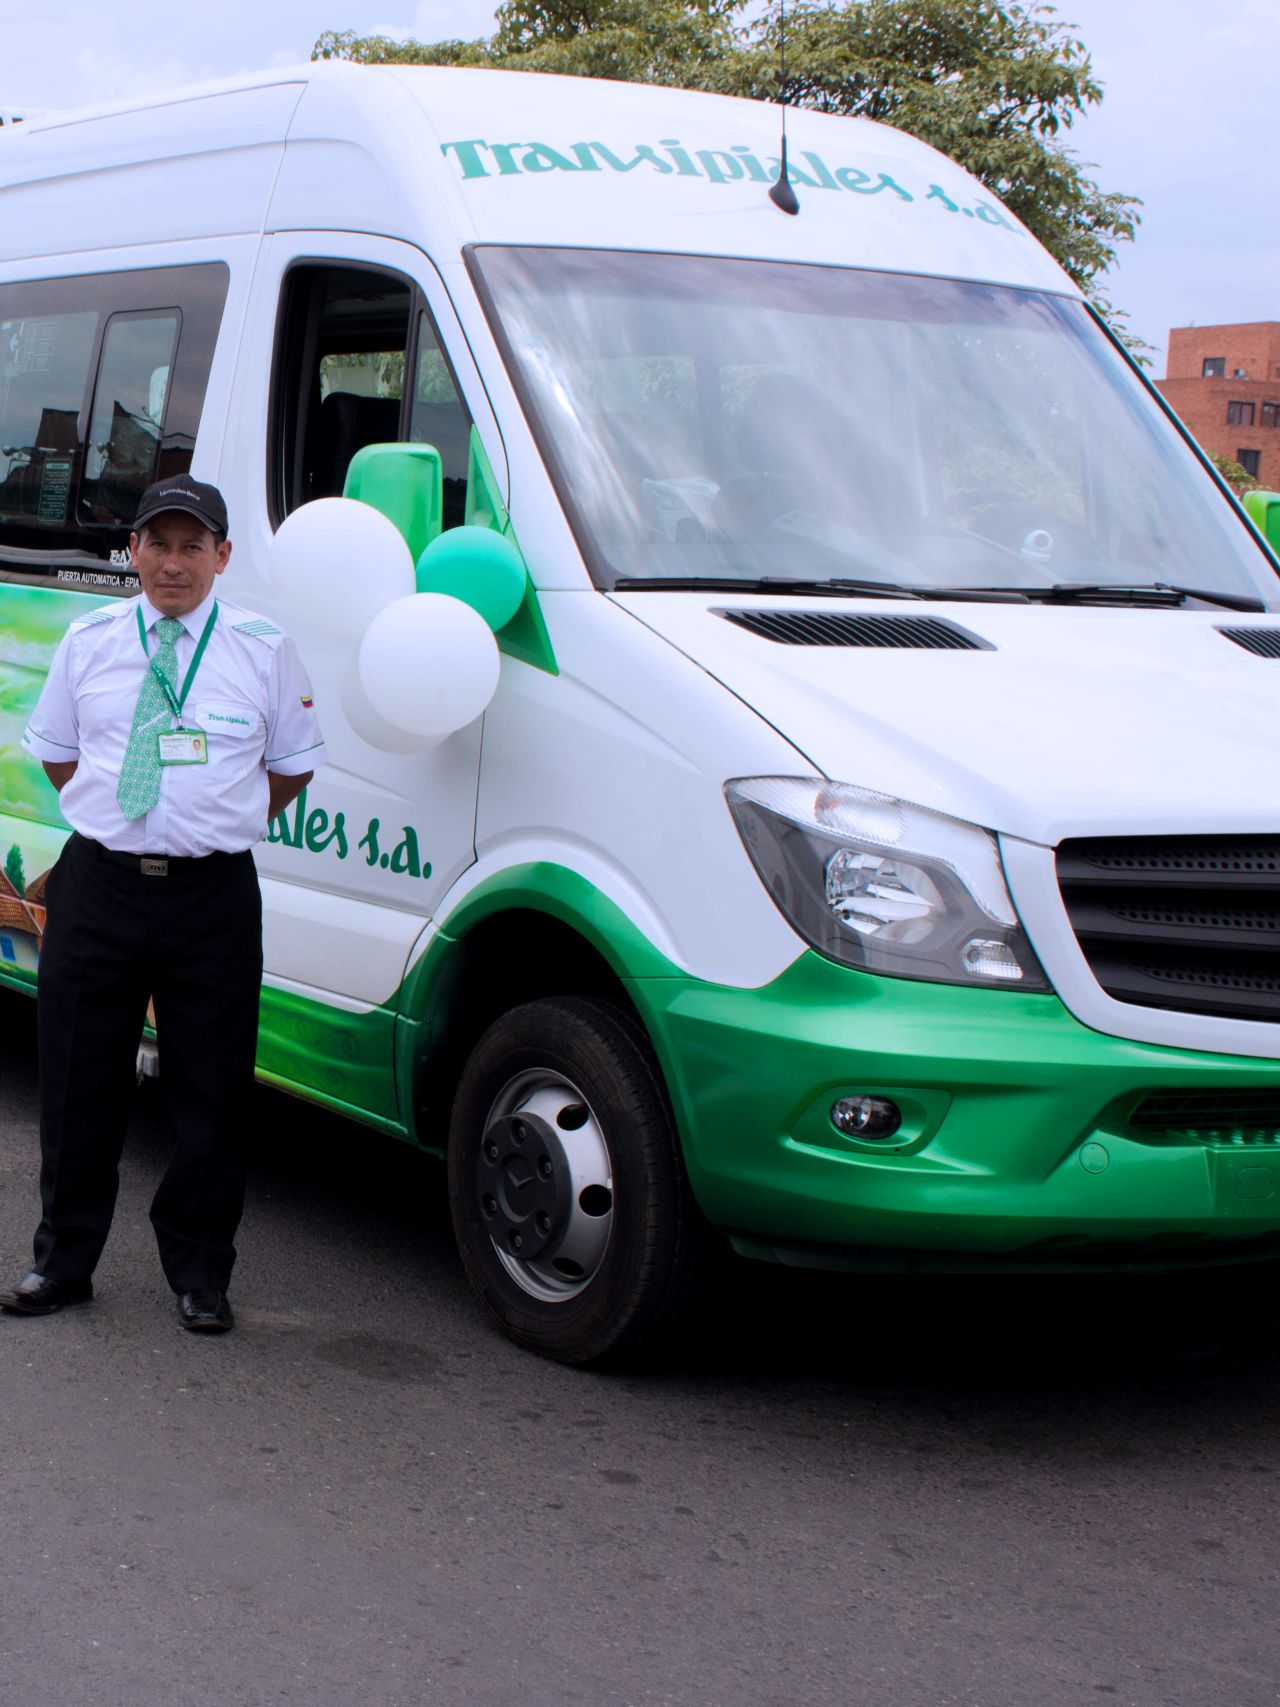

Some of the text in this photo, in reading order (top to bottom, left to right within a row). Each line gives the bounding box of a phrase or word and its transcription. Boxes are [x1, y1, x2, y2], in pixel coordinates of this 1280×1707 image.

[440, 139, 914, 203] Transipiales
[57, 570, 80, 582] PUERTA
[81, 573, 120, 586] AUTOMATICA
[266, 786, 432, 880] ales s.a.
